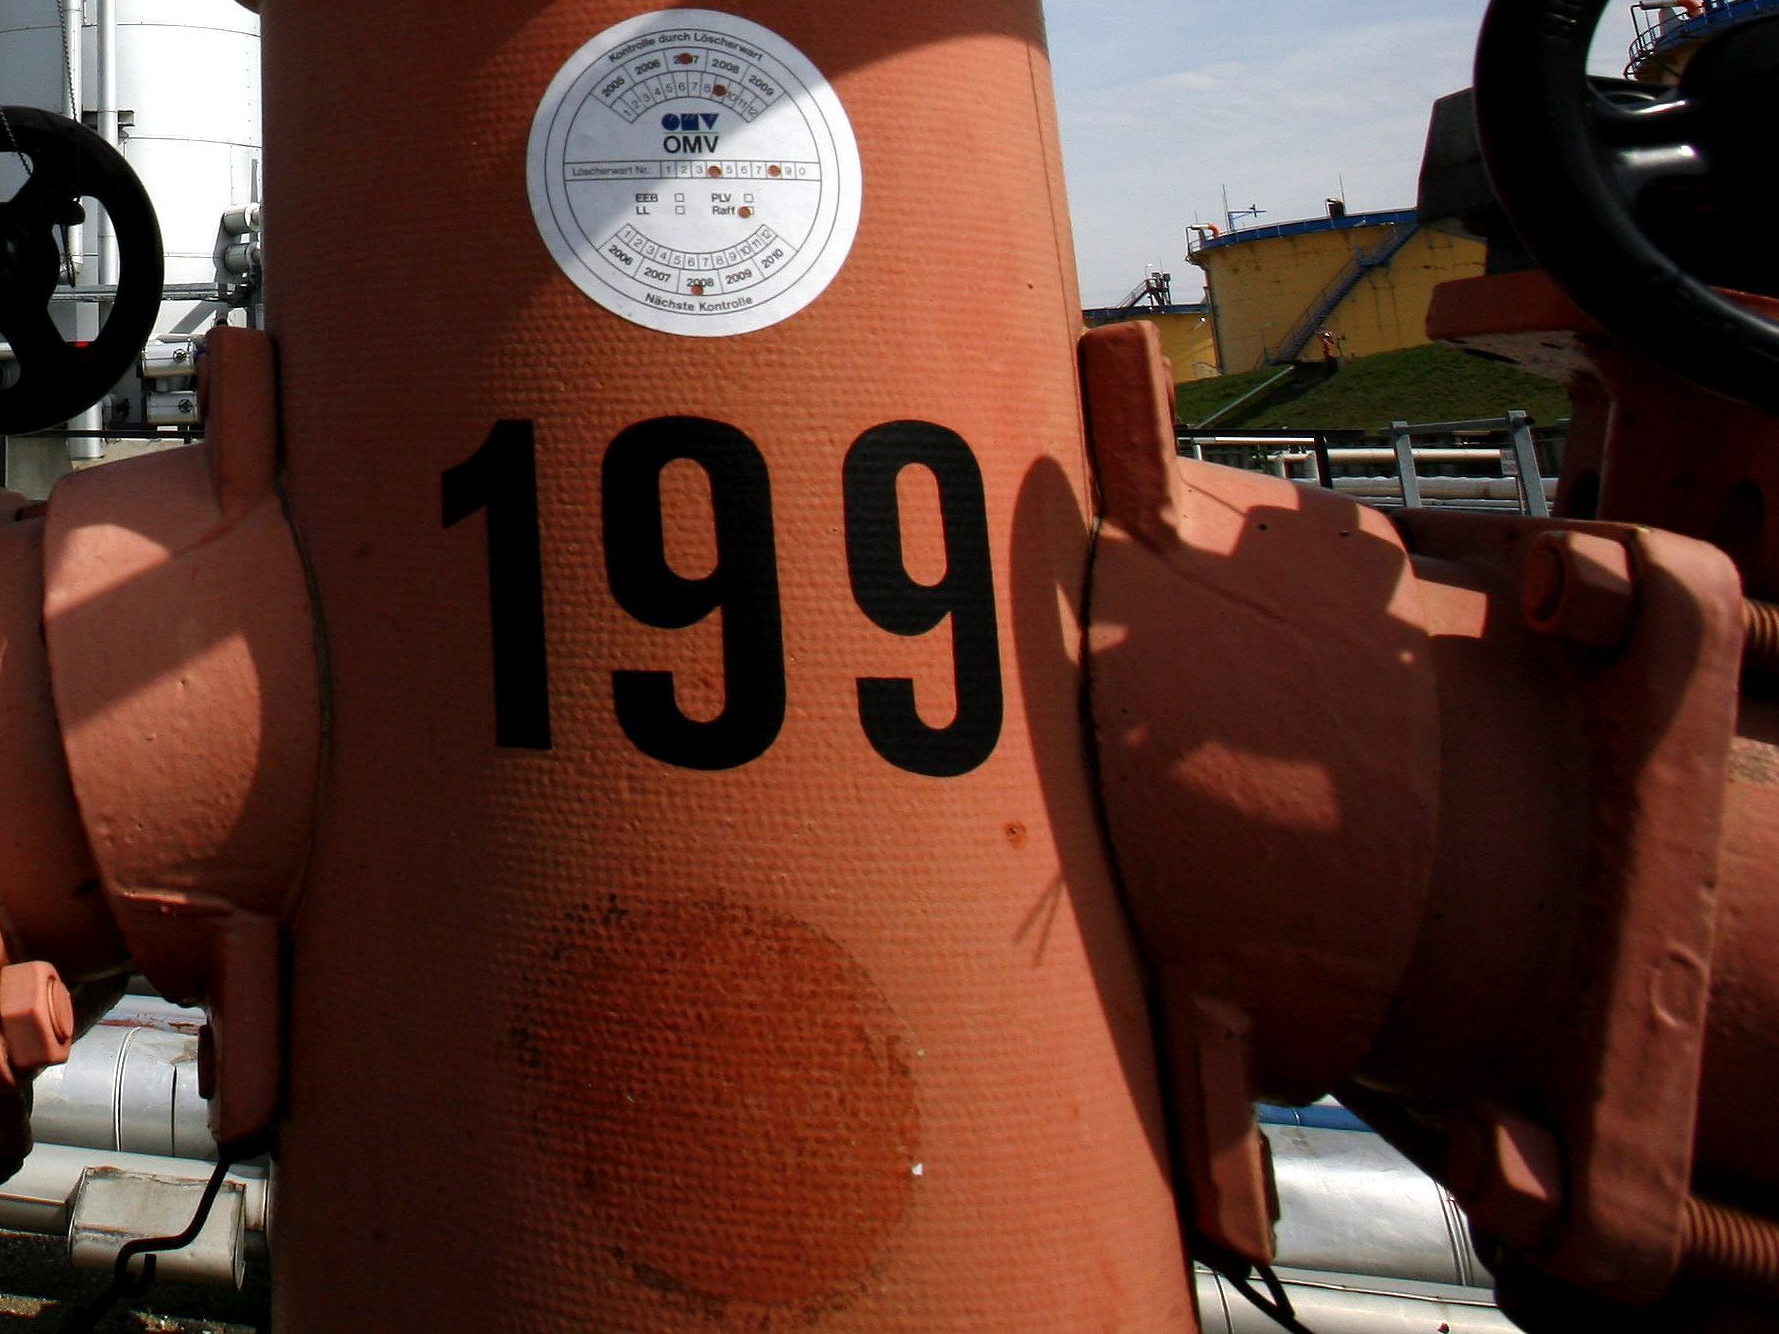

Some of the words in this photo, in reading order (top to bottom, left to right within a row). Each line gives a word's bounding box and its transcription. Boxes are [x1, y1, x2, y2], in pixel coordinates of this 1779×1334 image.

[609, 38, 655, 63] Kontrolle
[658, 32, 691, 43] durch
[693, 33, 764, 62] Löscherwart
[601, 76, 626, 97] 2005
[634, 59, 661, 74] 2006
[673, 54, 699, 64] 27
[712, 59, 740, 74] 2008
[748, 75, 774, 96] 2009
[665, 83, 673, 92] 5
[678, 82, 686, 90] 6
[691, 82, 698, 90] 7
[663, 135, 718, 153] OMV
[680, 166, 687, 174] 2
[696, 165, 703, 174] 3
[756, 166, 762, 174] 7
[712, 193, 731, 203] PLV
[636, 206, 650, 215] LL
[633, 237, 643, 248] 2
[647, 245, 656, 255] 3
[660, 251, 668, 261] 4
[687, 257, 695, 267] 6
[701, 257, 709, 267] 7
[716, 255, 724, 265] 8
[729, 252, 736, 262] 9
[740, 245, 751, 255] 10
[752, 238, 762, 248] 11
[608, 244, 634, 266] 2006
[644, 267, 671, 283] 2007
[686, 278, 714, 288] 2008
[725, 270, 753, 285] 2009
[761, 249, 784, 268] 2010
[645, 292, 695, 312] Nächste
[699, 296, 754, 312] Kontrolle
[440, 415, 1004, 778] 199
